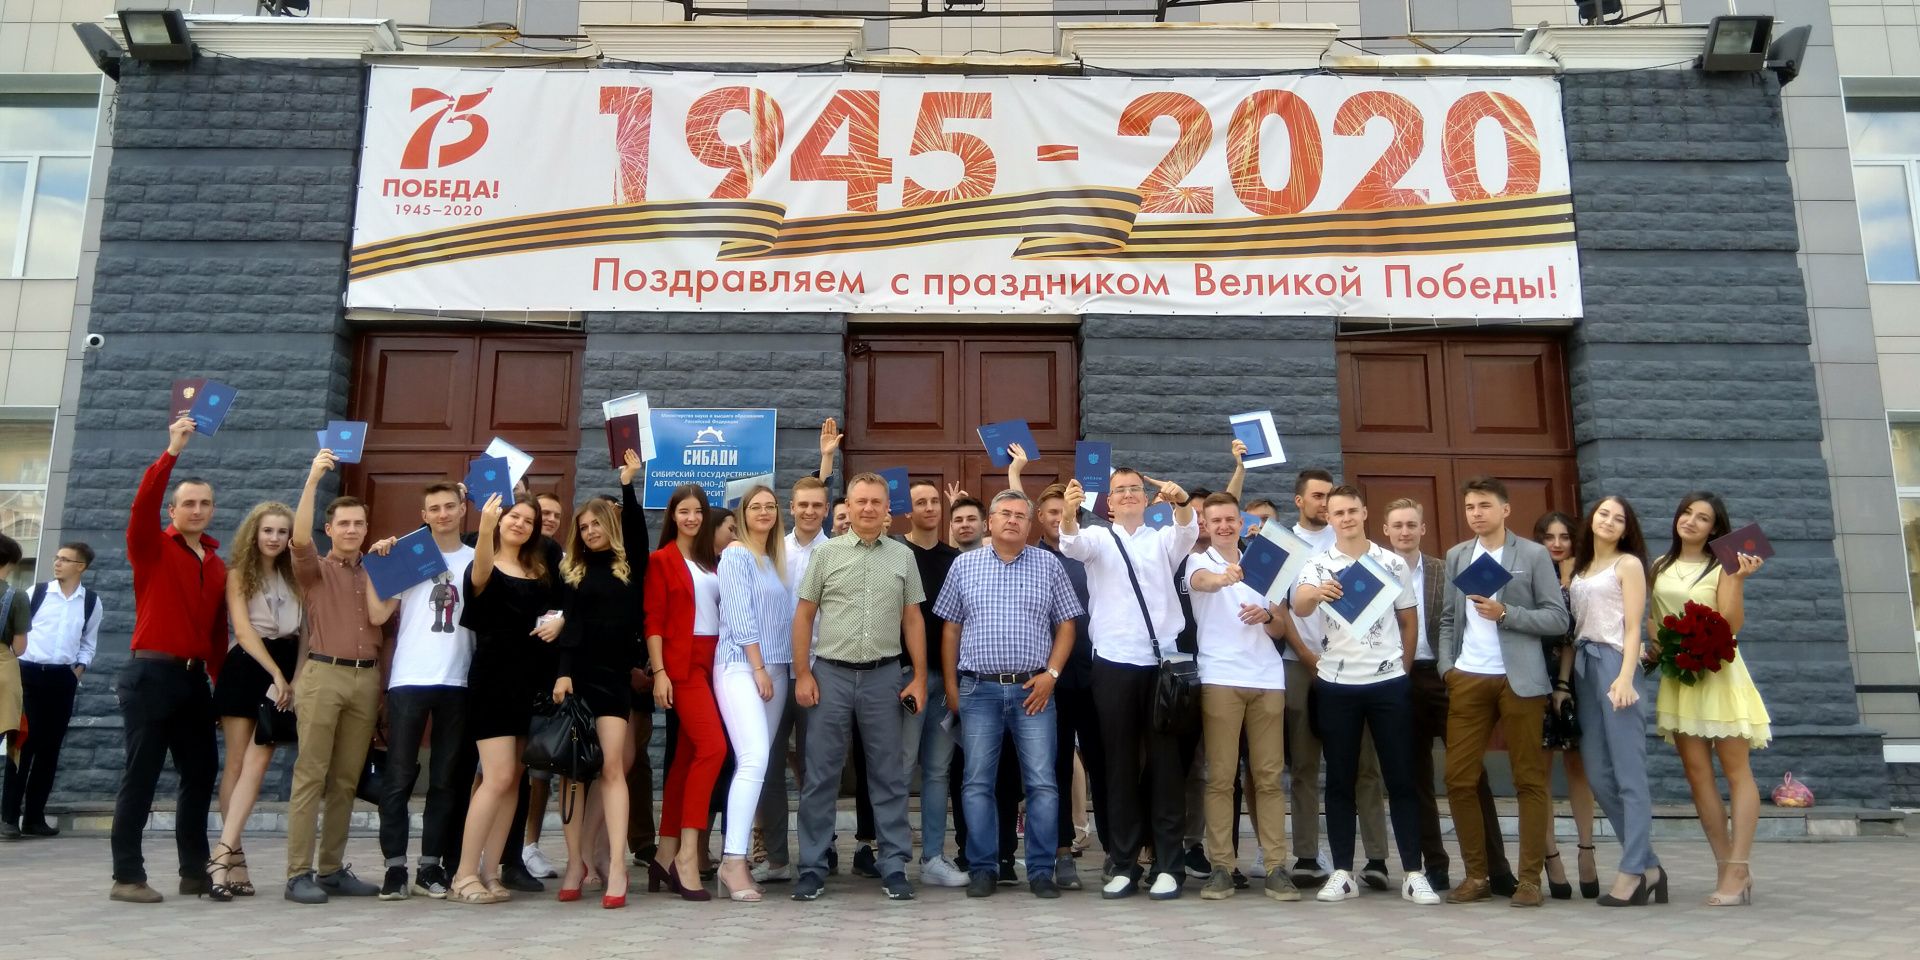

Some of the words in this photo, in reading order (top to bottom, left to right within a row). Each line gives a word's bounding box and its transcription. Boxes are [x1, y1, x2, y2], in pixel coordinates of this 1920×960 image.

[599, 86, 998, 212] 1945
[1117, 91, 1541, 216] 2020
[383, 178, 500, 202] ПОБЕДА!
[592, 257, 865, 303] Поздравляем
[891, 273, 909, 296] с
[924, 273, 1170, 305] праздником
[1194, 263, 1362, 297] Великой
[1385, 263, 1558, 305] Победы!
[683, 449, 738, 466] СИБАДИ
[651, 470, 695, 478] СИБИРСКИЙ
